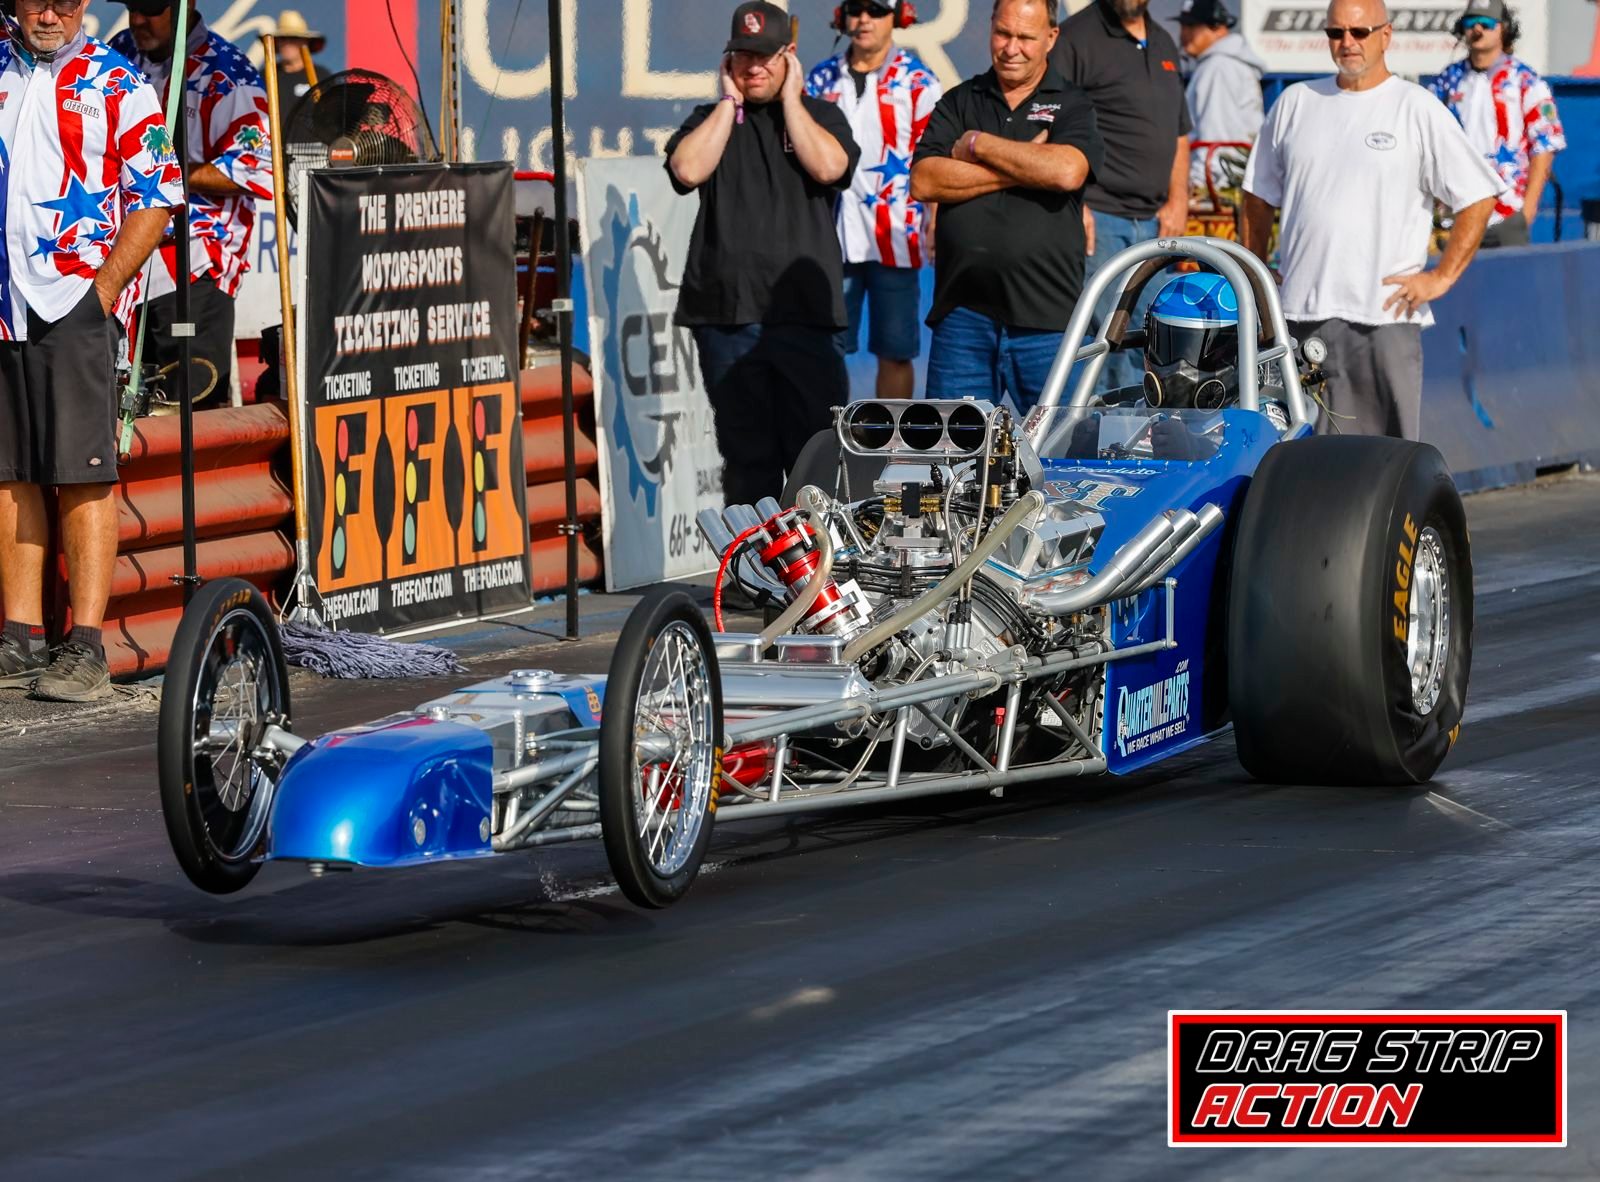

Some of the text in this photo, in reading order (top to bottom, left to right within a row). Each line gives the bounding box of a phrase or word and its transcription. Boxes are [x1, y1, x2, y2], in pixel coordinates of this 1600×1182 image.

[63, 99, 100, 118] OFFICIAL
[359, 190, 466, 234] THE PREMIERE
[362, 247, 463, 293] MOTORSPORTS
[335, 301, 491, 355] TICKETING SERVICE
[325, 355, 505, 400] TICKETING TICKETING TICKETING
[322, 561, 523, 622] THEFOAT.COM THEFOAT.COM THEFOAT.COM
[1392, 511, 1419, 646] EAGLE
[1136, 733, 1150, 750] RACE
[1150, 728, 1166, 745] WHAT
[1174, 720, 1187, 734] SELL
[707, 746, 723, 814] EAGLE
